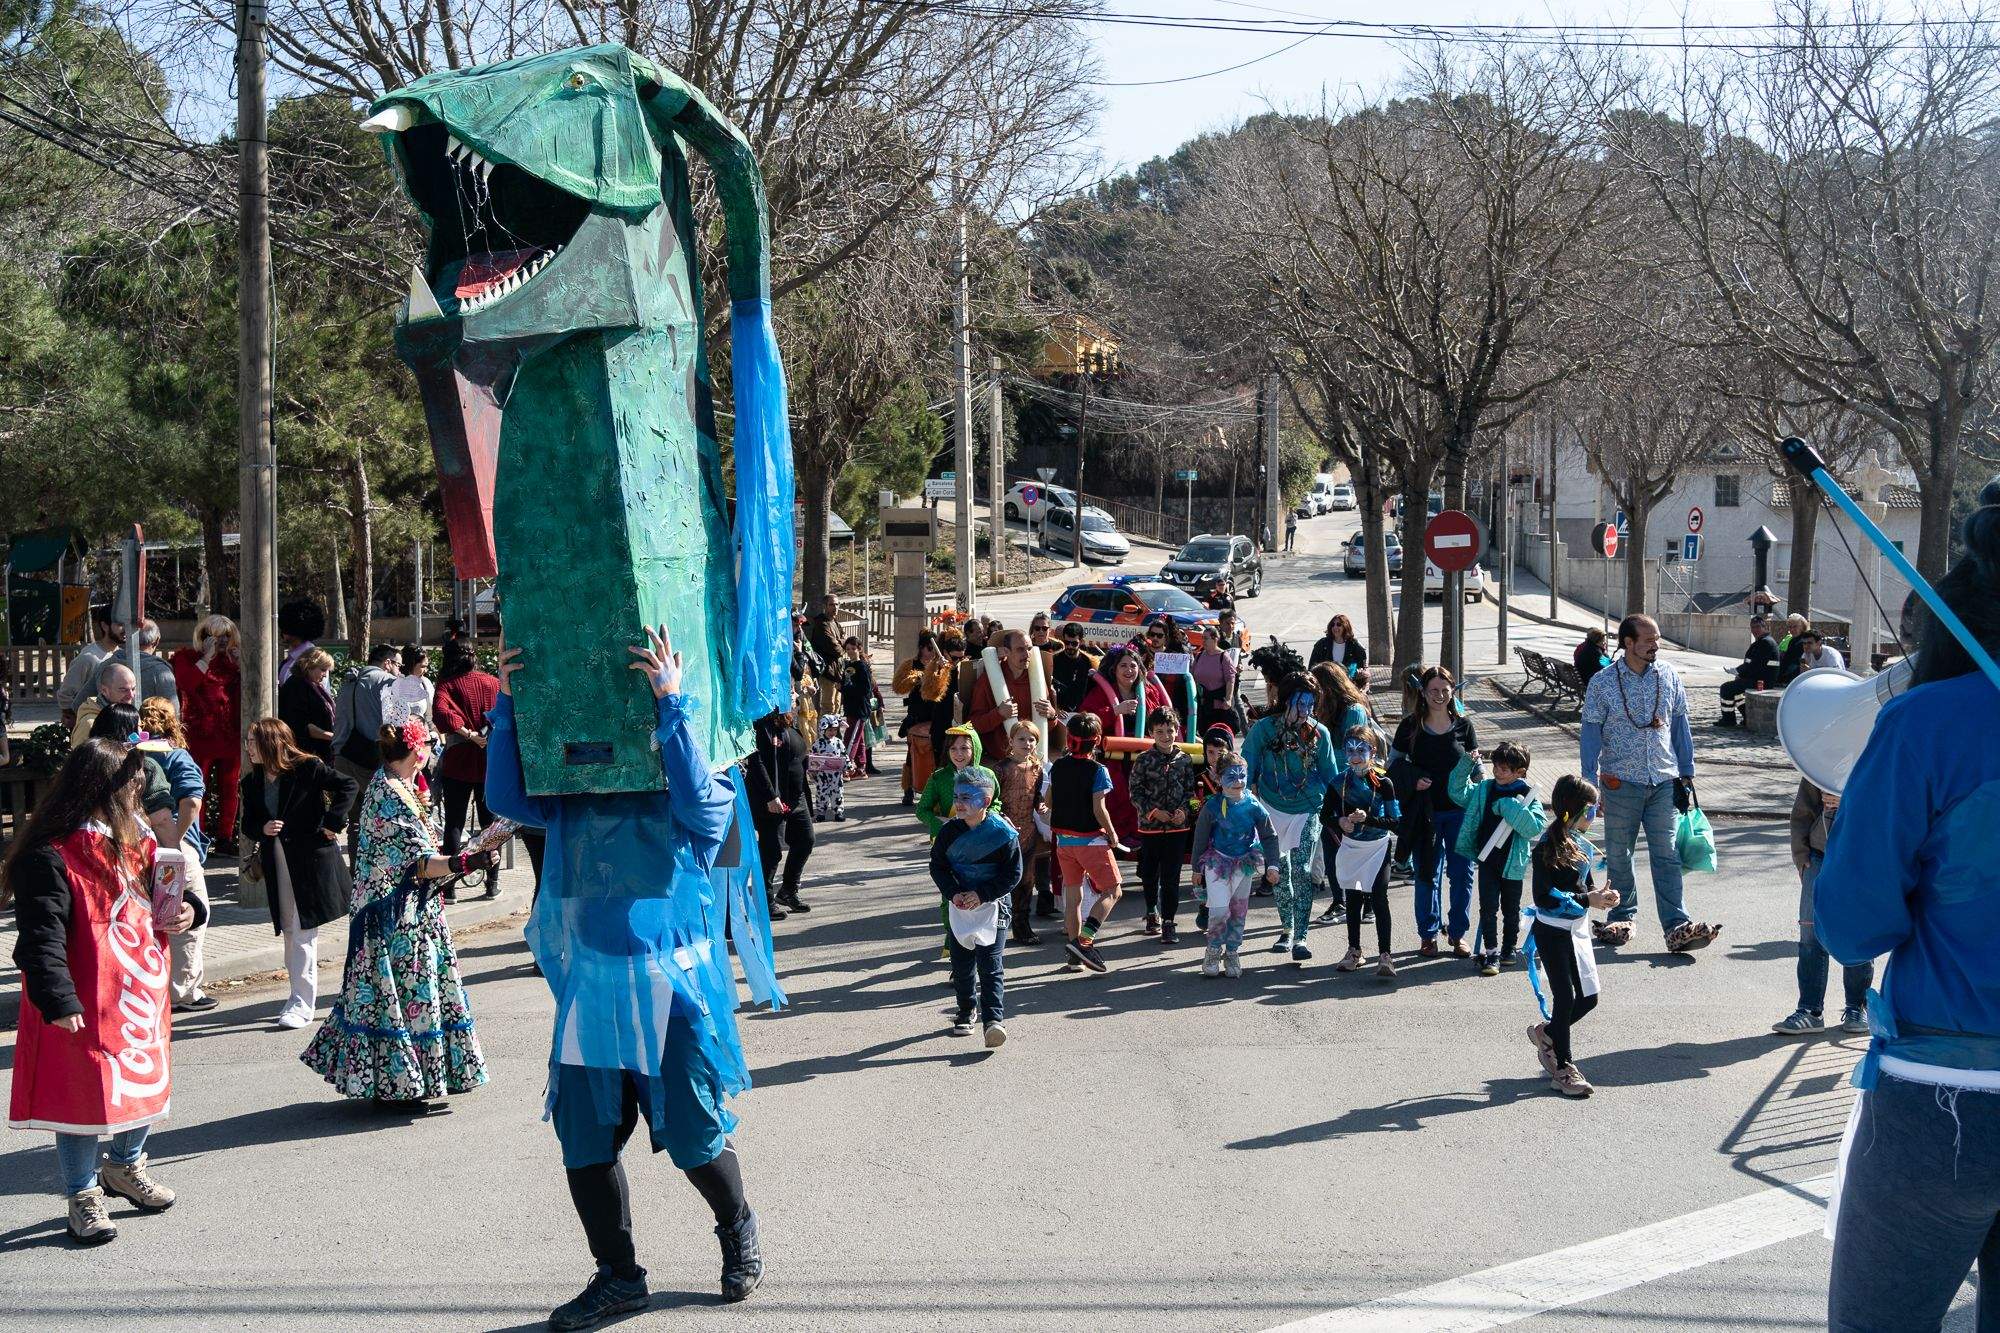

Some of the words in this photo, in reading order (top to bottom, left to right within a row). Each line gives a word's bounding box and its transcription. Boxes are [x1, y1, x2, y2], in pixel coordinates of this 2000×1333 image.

[1605, 537, 1617, 546] STOP
[1083, 626, 1119, 638] protecció
[1121, 627, 1137, 639] civil
